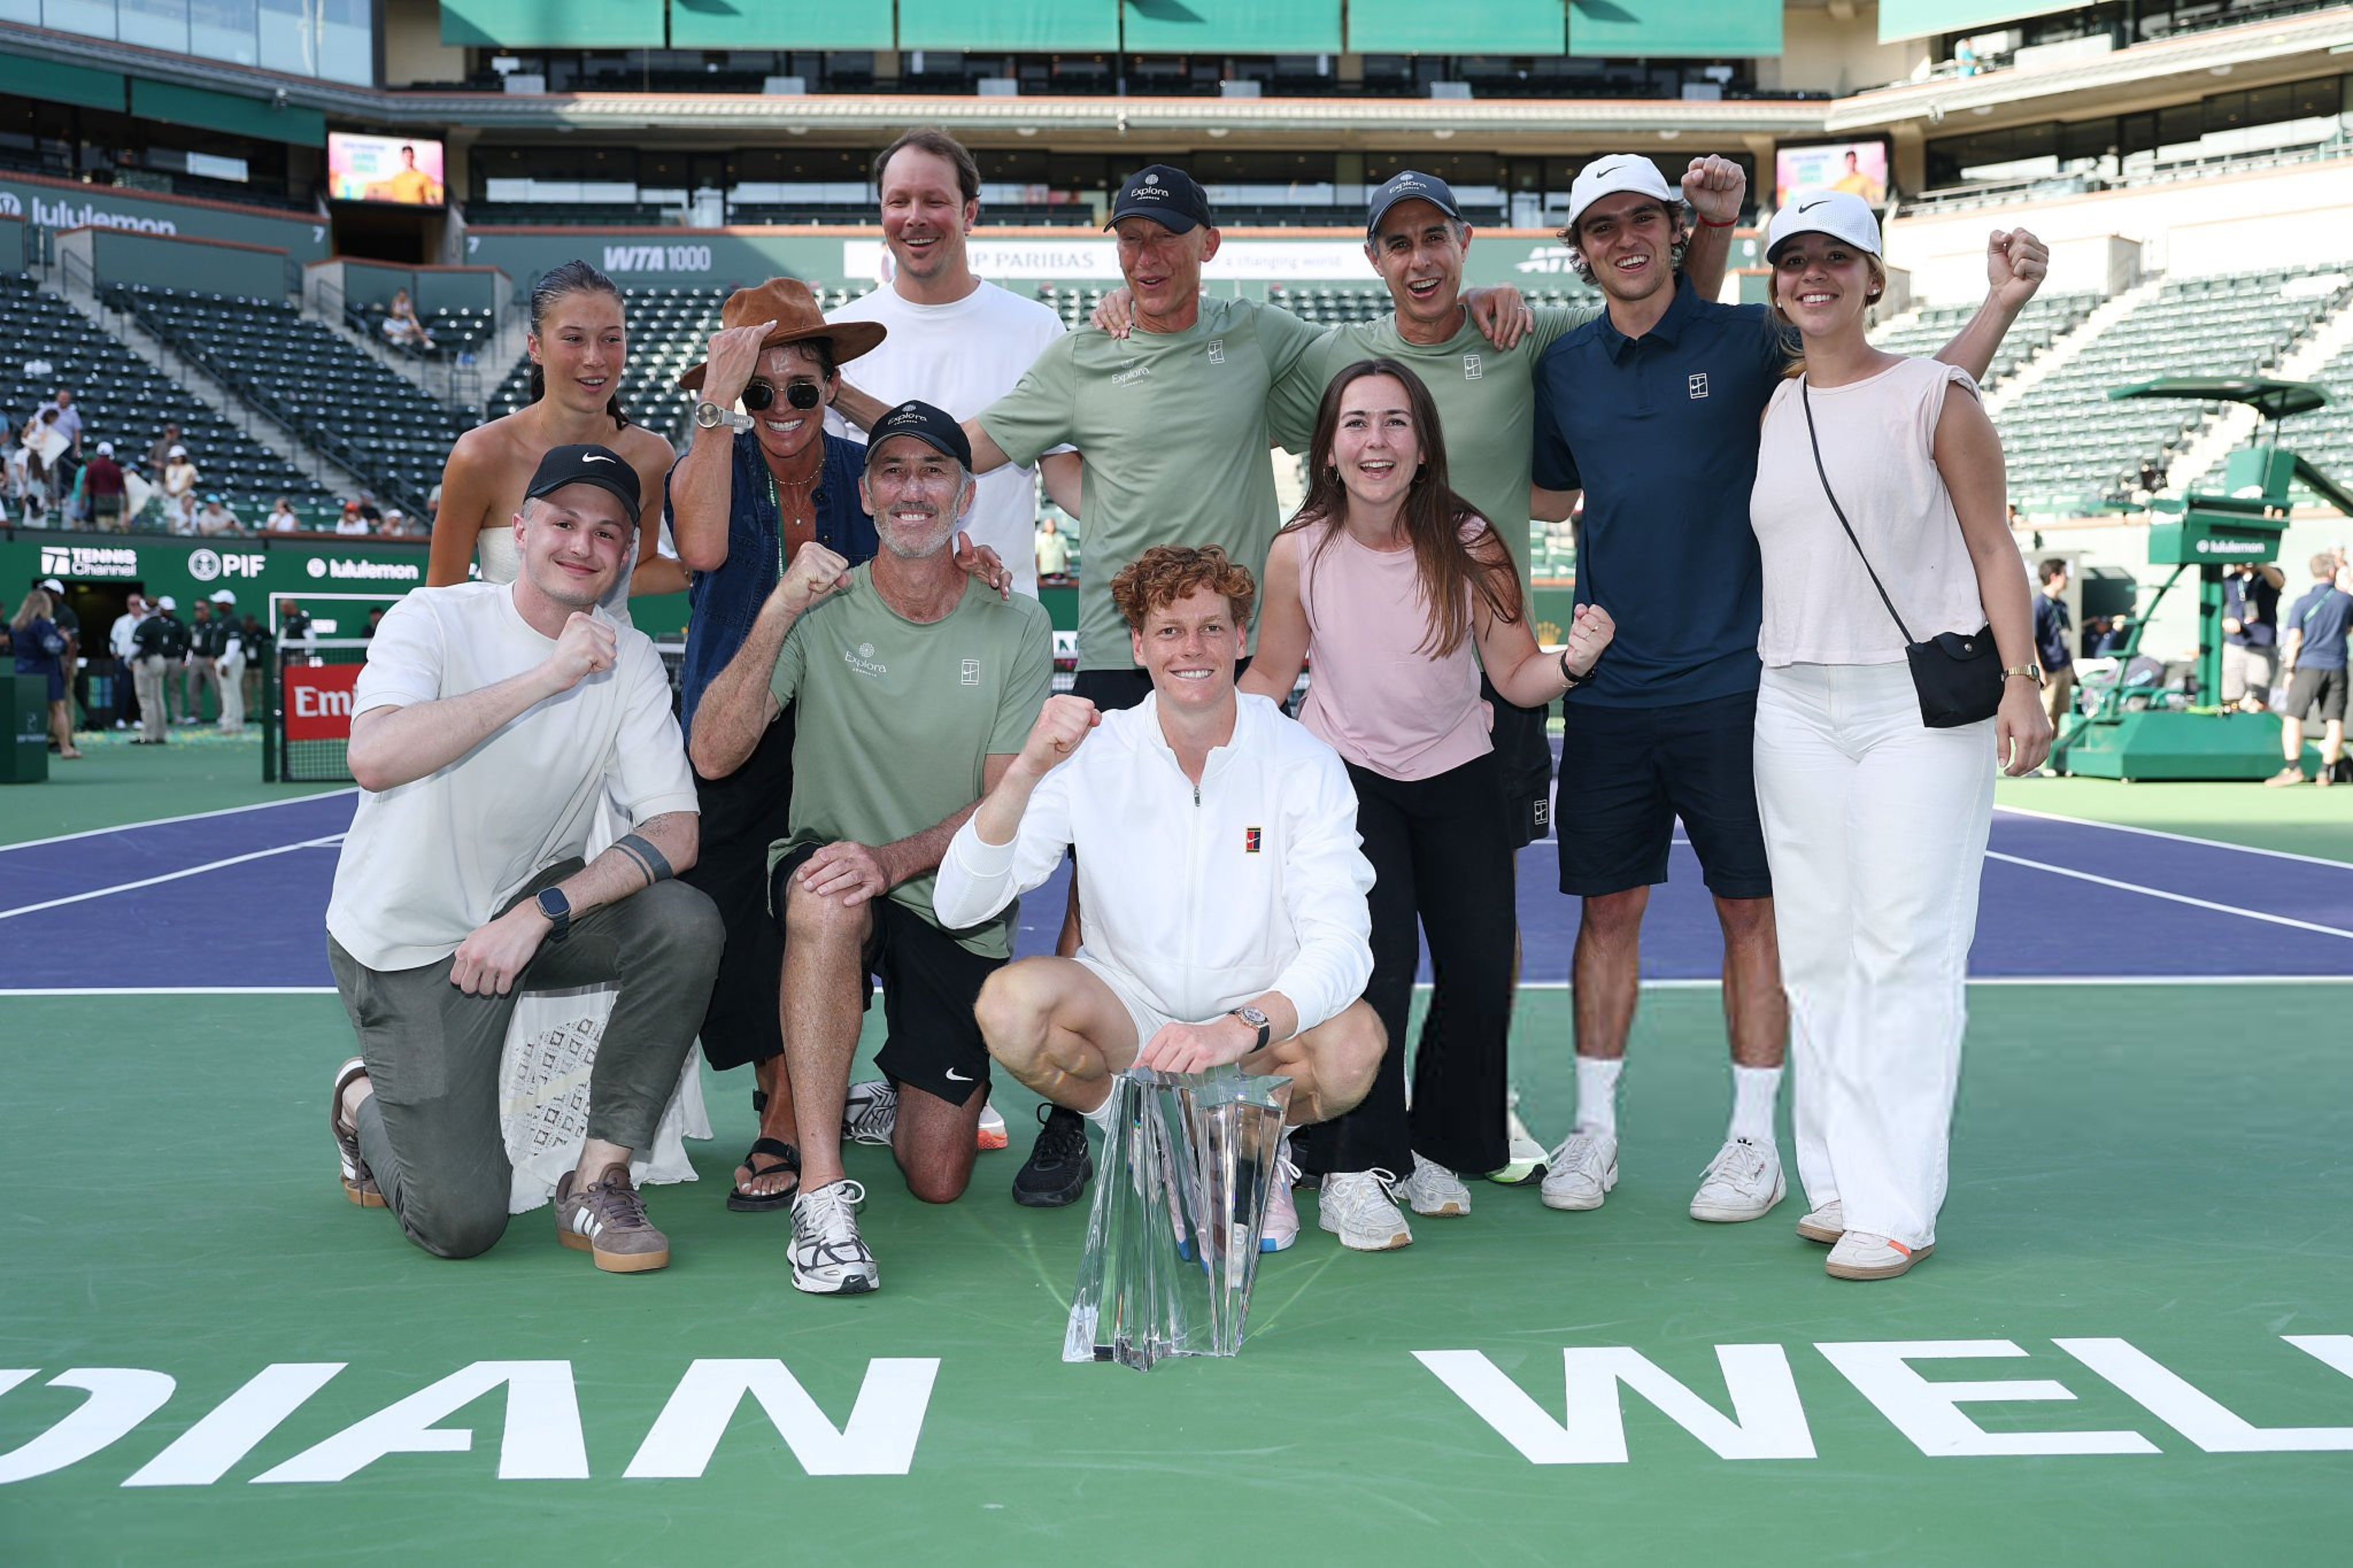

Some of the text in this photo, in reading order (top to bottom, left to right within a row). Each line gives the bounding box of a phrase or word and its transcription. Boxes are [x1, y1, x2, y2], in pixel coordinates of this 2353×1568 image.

[1131, 186, 1168, 198] Explora
[1389, 180, 1426, 194] Explora
[32, 196, 176, 236] lululemon
[313, 226, 325, 243] 7
[467, 236, 480, 254] 7
[1742, 239, 1756, 257] 8
[604, 246, 712, 272] WTA 1000
[996, 252, 1095, 268] PARIBAS
[1112, 367, 1150, 385] Explora
[888, 412, 928, 426] Explora
[71, 547, 137, 564] TENNIS
[2210, 540, 2266, 554] lululemon
[72, 562, 137, 577] Channel
[222, 554, 266, 578] PIF
[330, 558, 419, 580] lululemon
[845, 651, 886, 673] Explora
[1409, 1334, 2353, 1465] WEL
